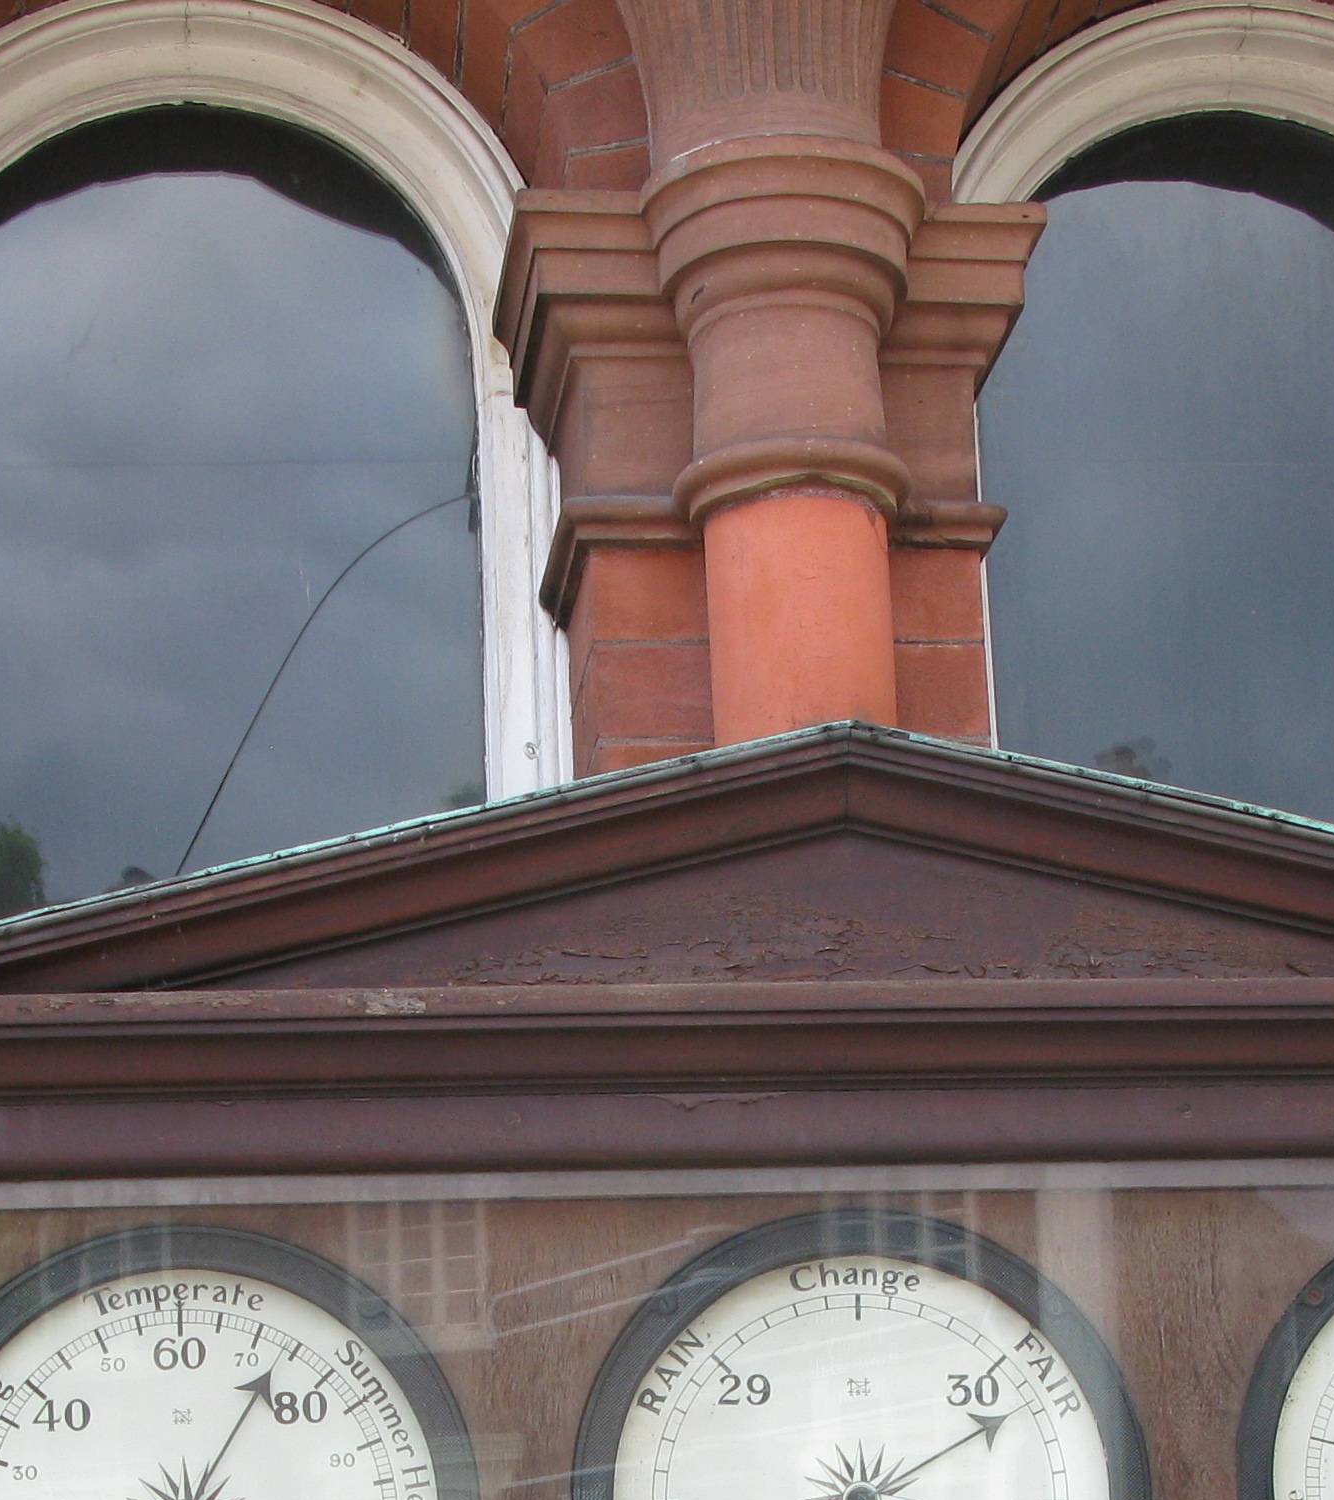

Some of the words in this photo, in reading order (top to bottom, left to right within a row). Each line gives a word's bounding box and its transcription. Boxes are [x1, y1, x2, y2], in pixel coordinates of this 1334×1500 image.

[790, 1262, 921, 1294] Change
[84, 1280, 264, 1317] Temperate
[100, 1356, 126, 1373] 50
[153, 1337, 206, 1370] 60
[234, 1352, 260, 1368] 70
[638, 1327, 707, 1417] RAIN
[1013, 1332, 1083, 1418] FAIR
[334, 1339, 415, 1459] Summer
[718, 1374, 771, 1406] 29
[946, 1374, 999, 1406] 30
[33, 1399, 91, 1432] 40
[273, 1391, 328, 1424] 80
[12, 1465, 38, 1481] 30
[329, 1453, 356, 1468] 90
